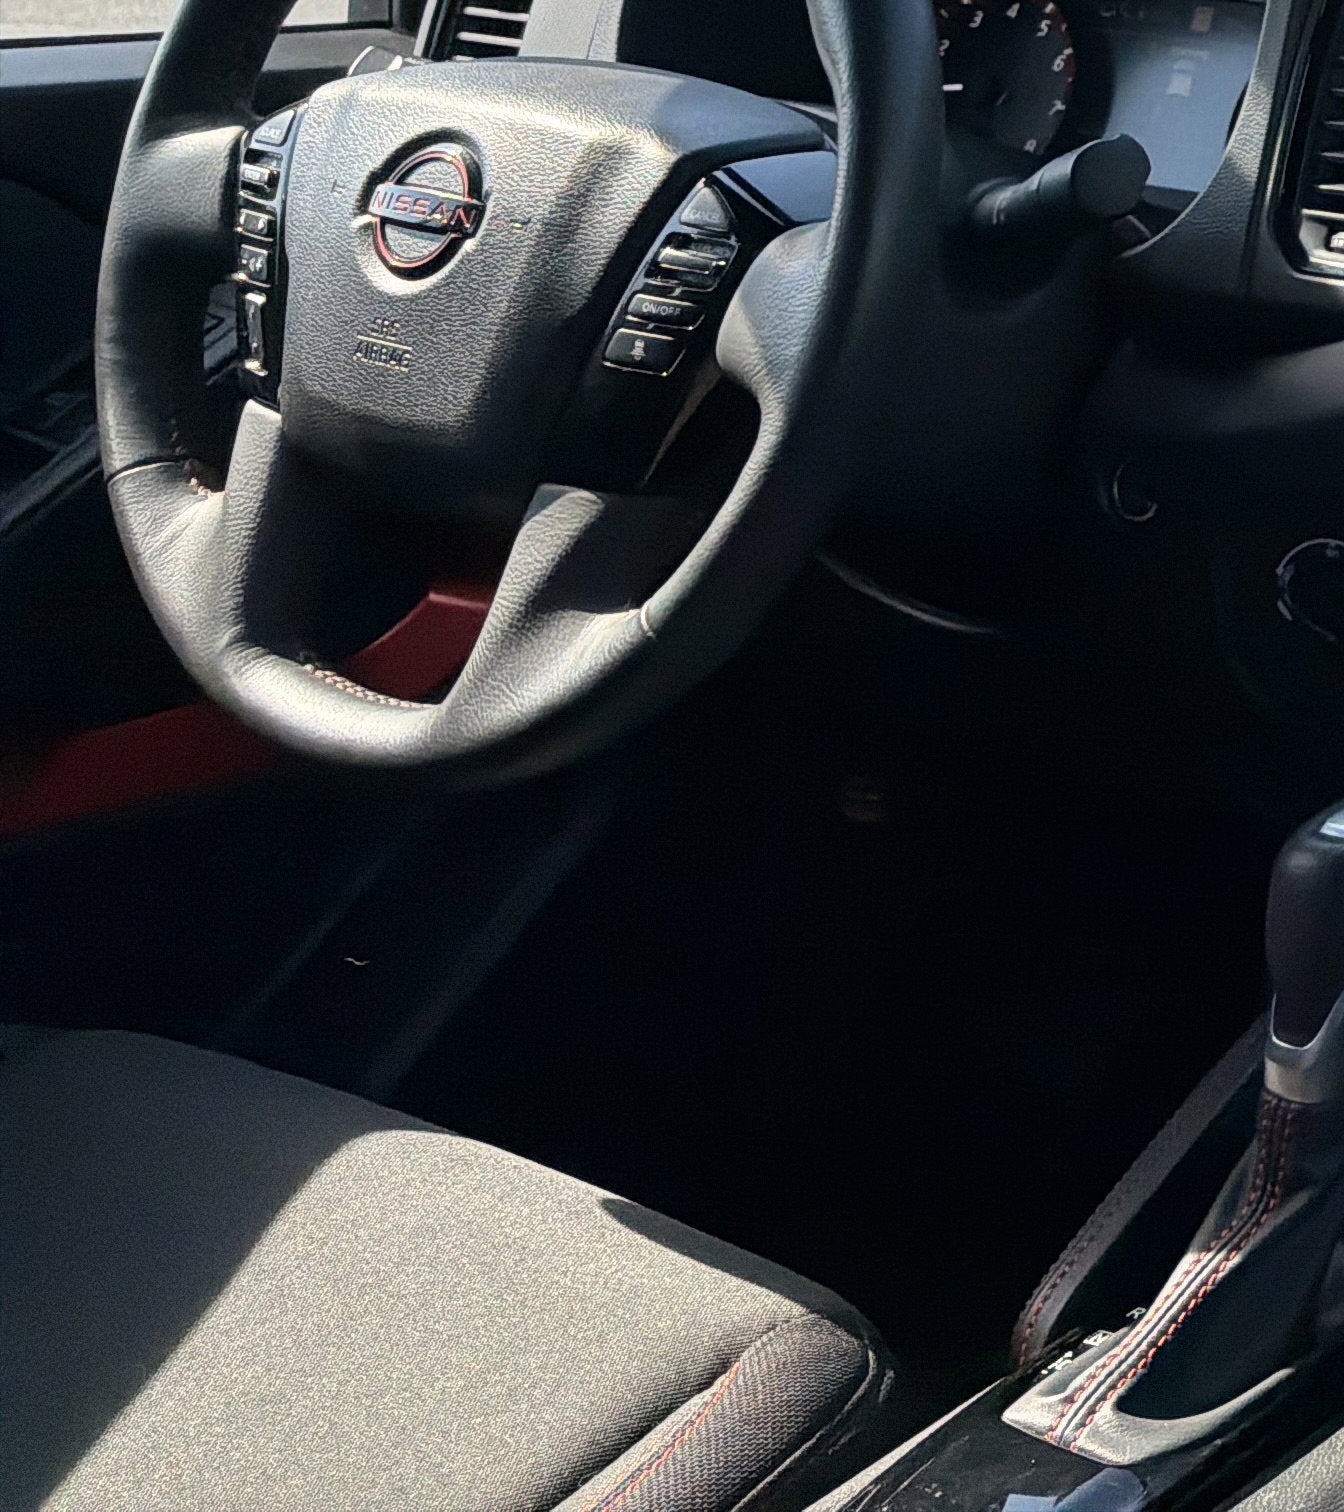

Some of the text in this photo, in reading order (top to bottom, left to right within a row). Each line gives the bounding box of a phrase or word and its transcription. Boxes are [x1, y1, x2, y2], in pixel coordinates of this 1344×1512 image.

[968, 10, 984, 28] 3
[1006, 2, 1021, 19] 4
[1036, 19, 1052, 37] 5
[1052, 54, 1067, 72] 6
[371, 190, 477, 230] NISSAN
[642, 301, 682, 317] ON/OFF
